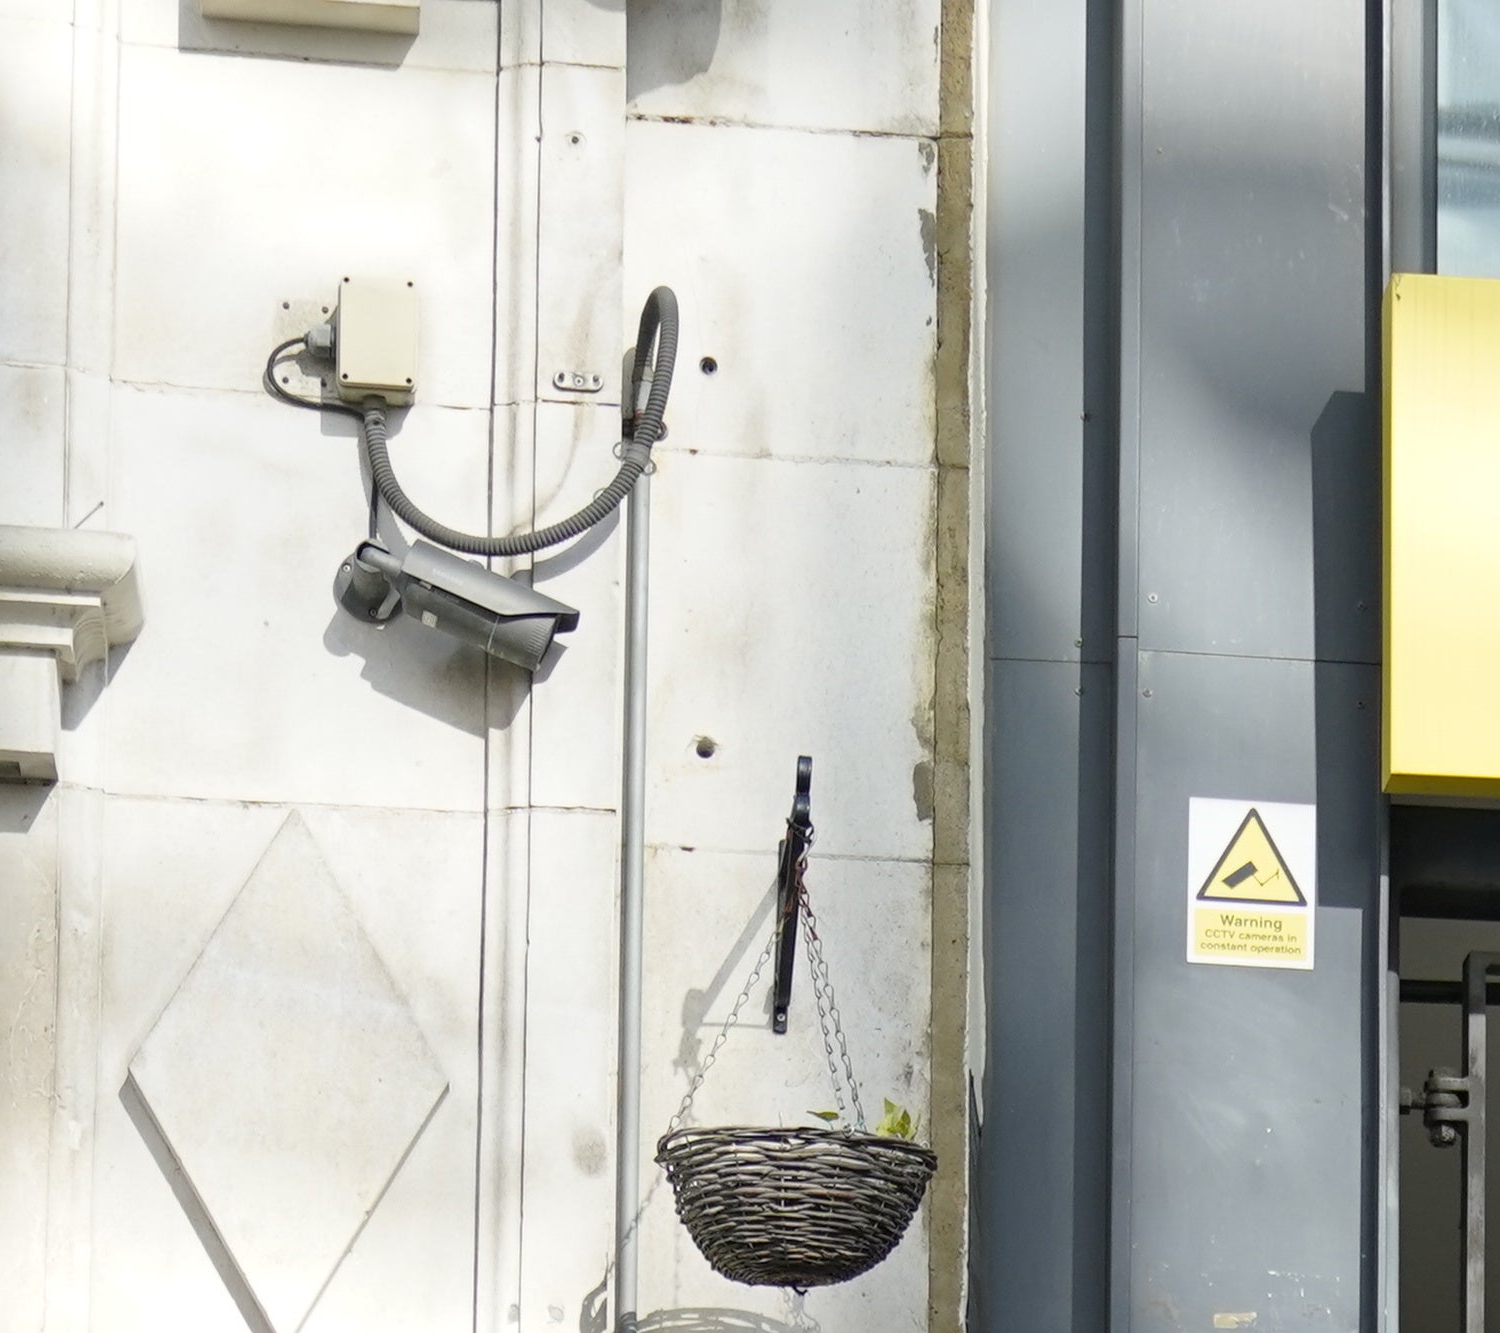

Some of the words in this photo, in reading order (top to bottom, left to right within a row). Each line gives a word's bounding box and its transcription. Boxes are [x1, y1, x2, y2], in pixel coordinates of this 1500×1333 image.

[1220, 914, 1283, 932] Warning
[1205, 929, 1235, 939] CCTV
[1238, 931, 1284, 943] cameras
[1288, 934, 1297, 943] in
[1200, 942, 1247, 952] constant
[1250, 945, 1301, 954] operation
